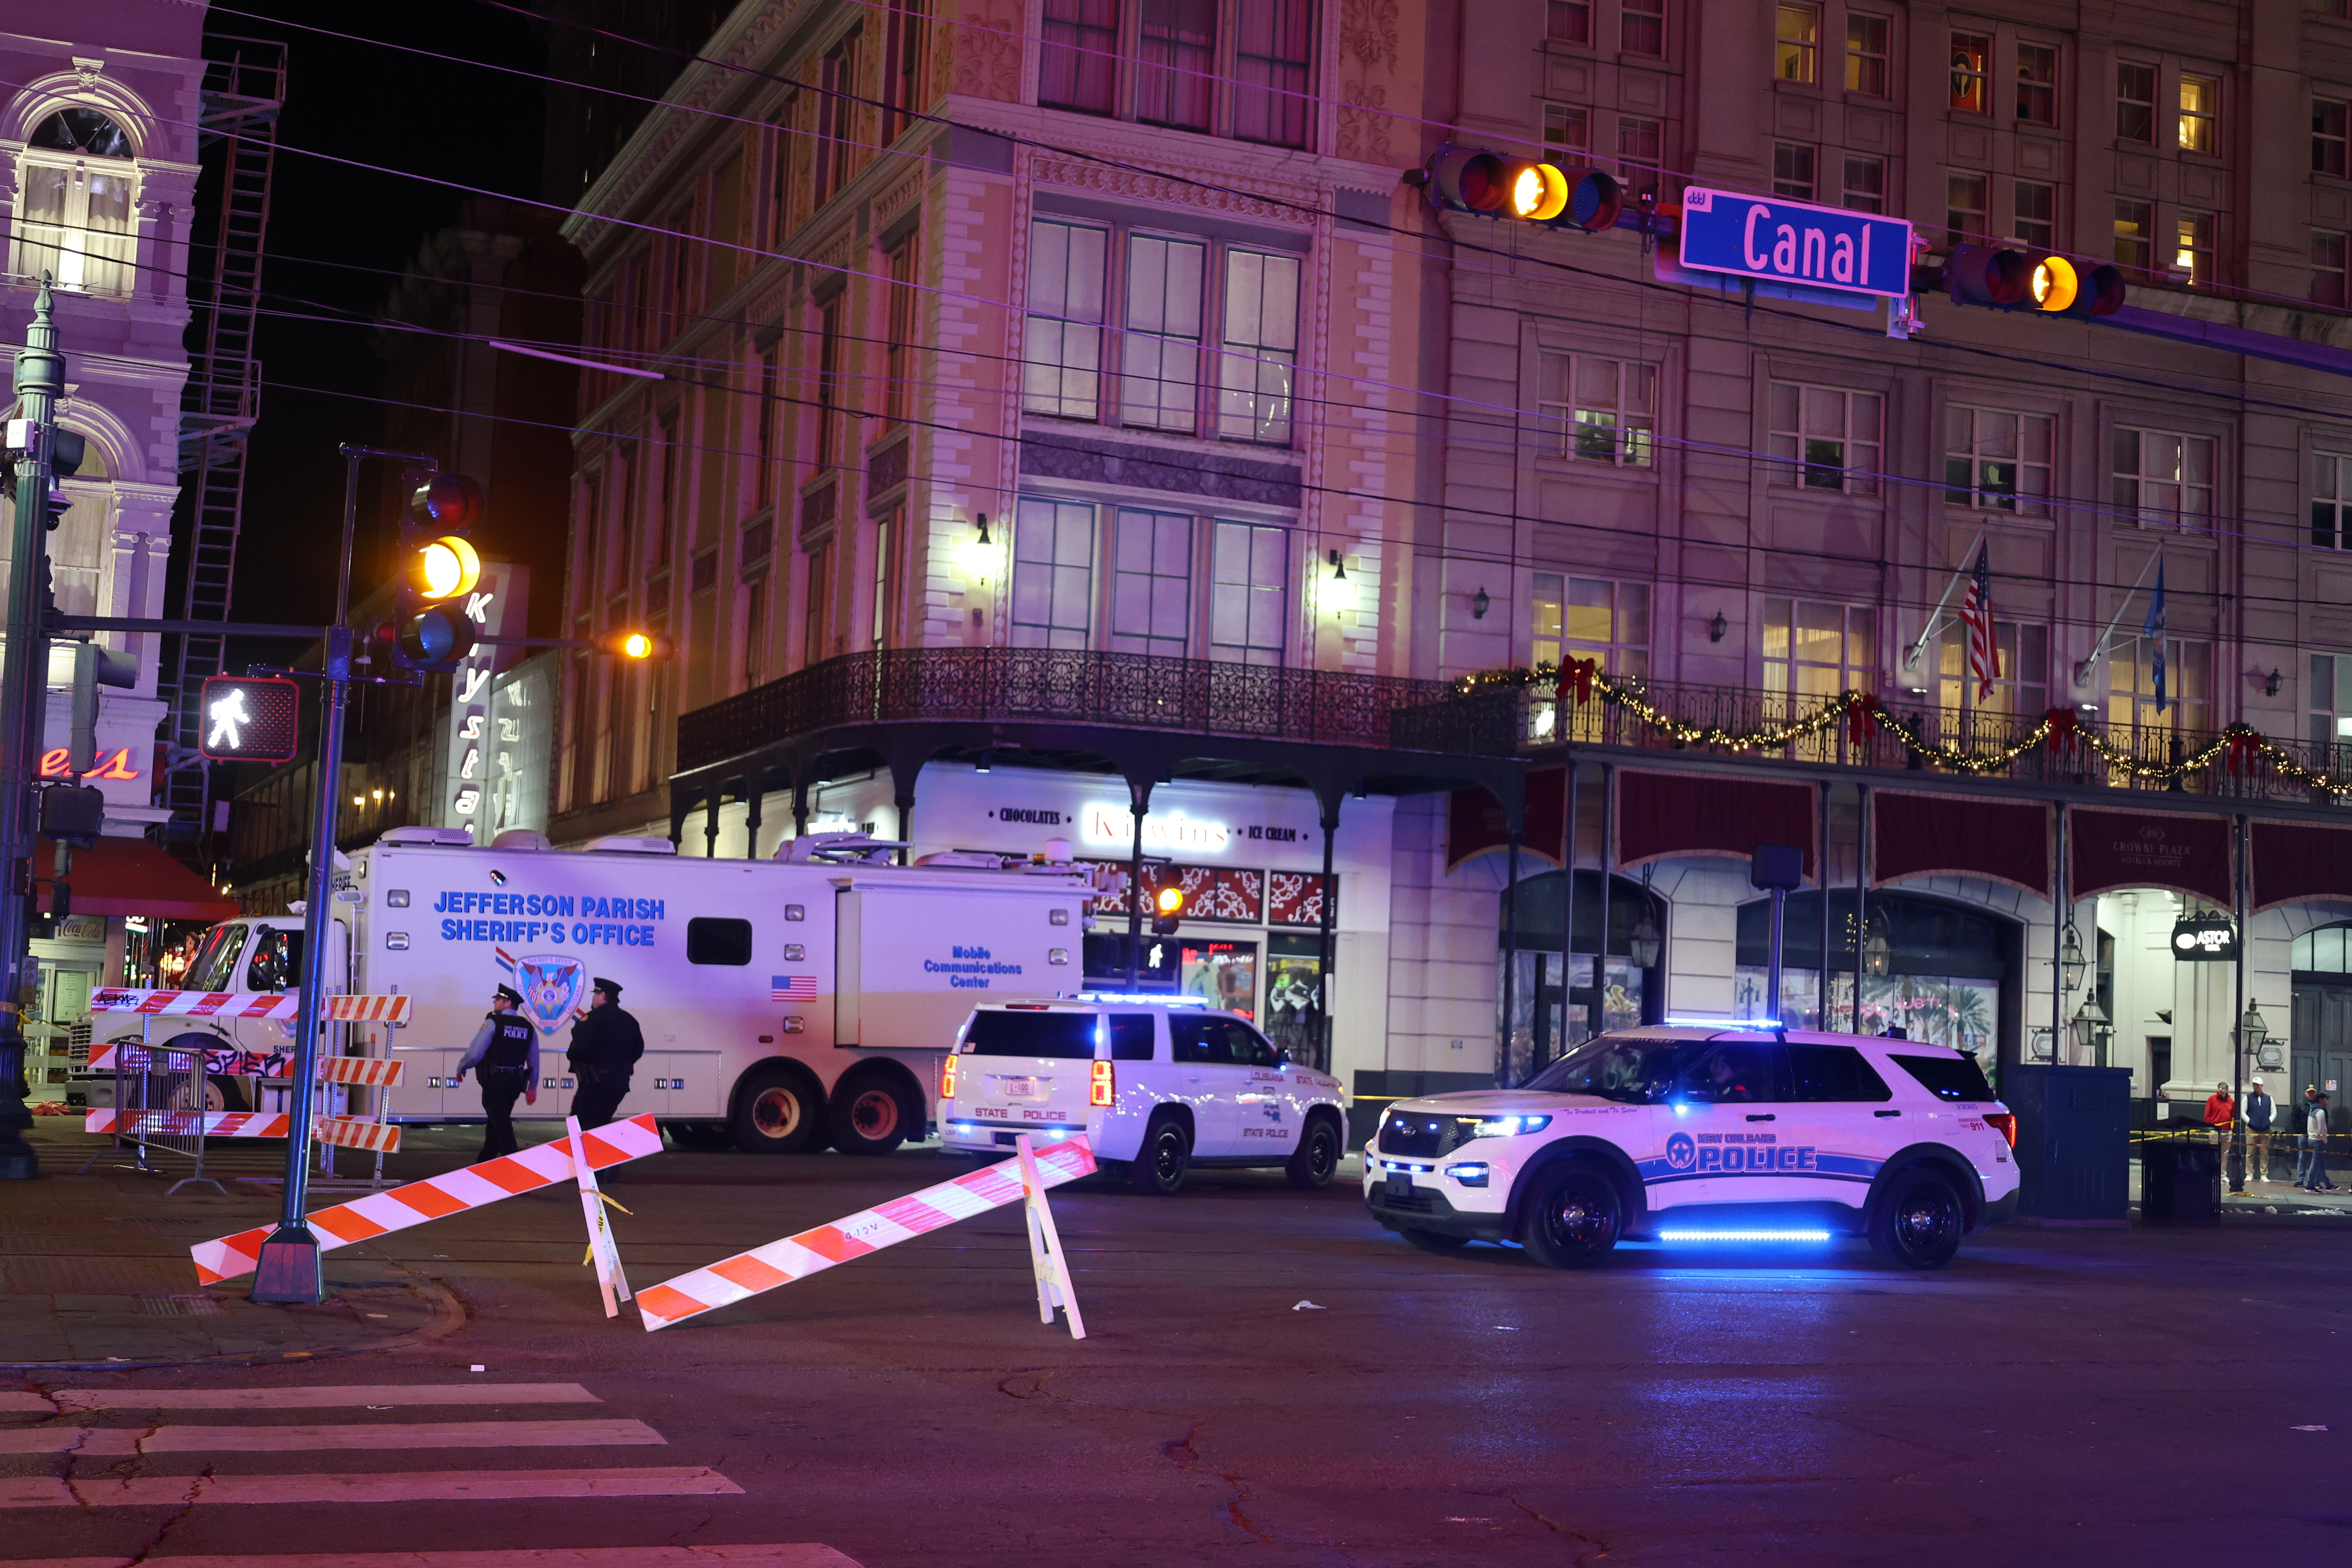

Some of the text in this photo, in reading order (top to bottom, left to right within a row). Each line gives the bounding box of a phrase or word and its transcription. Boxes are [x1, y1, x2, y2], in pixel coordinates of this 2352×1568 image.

[1744, 204, 1871, 285] Canal
[454, 592, 494, 833] Kysta
[1000, 808, 1060, 824] CHOCOLATES
[1094, 811, 1225, 843] Kiwins
[1249, 825, 1296, 842] ICE CREAM
[2113, 841, 2190, 855] CROWNE PLAZA
[2153, 858, 2180, 867] RESORTS
[331, 875, 351, 894] HERIFF
[434, 891, 664, 920] JEFFERSON PARISH
[441, 919, 654, 946] SHERIFF'S OFFICE
[2196, 930, 2230, 944] ASTOR
[953, 946, 991, 959] Mobile
[924, 960, 1022, 975] Communications
[950, 975, 989, 988] Center
[504, 1029, 528, 1039] POLICE
[273, 1045, 295, 1053] SHER
[1250, 1071, 1284, 1082] LOUISIANA
[1296, 1075, 1313, 1085] STATE
[975, 1108, 1066, 1120] STATE POLICE
[1243, 1128, 1289, 1138] STATE POLICE
[1697, 1133, 1776, 1144] NEW ORLEANS
[1697, 1146, 1817, 1171] POLICE
